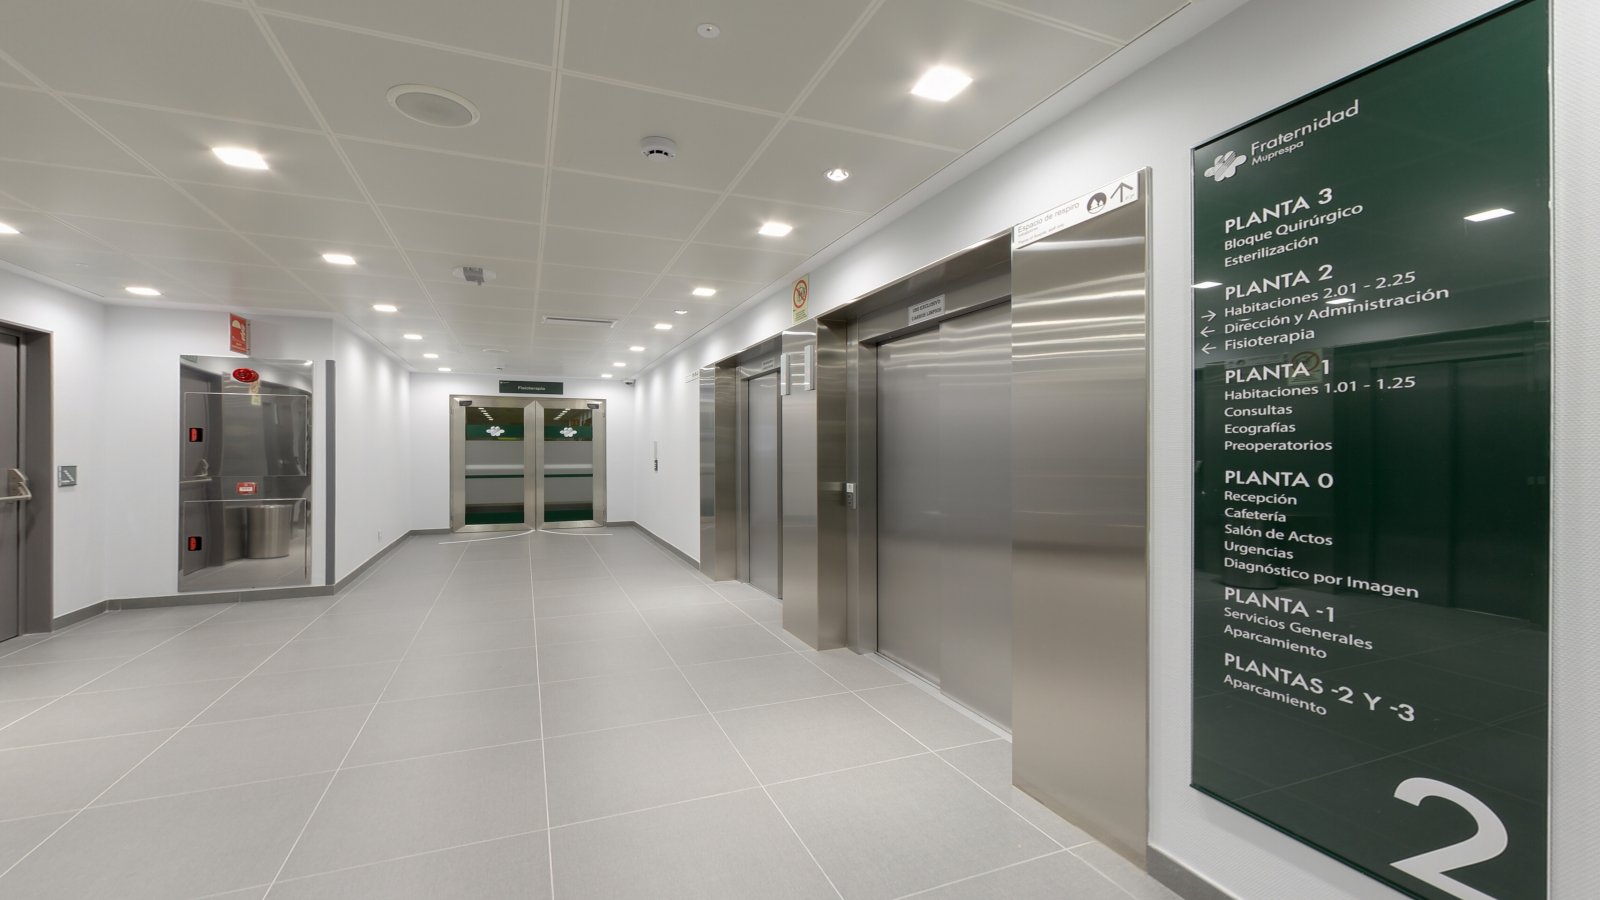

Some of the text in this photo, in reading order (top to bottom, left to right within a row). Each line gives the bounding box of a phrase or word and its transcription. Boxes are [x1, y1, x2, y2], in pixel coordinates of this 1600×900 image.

[1251, 99, 1359, 156] Fraternidad
[1251, 141, 1304, 166] Muprespa
[1018, 218, 1043, 233] Espacio
[1044, 213, 1053, 222] de
[1054, 202, 1080, 217] respiro
[1224, 204, 1364, 251] Bloque Quirúrgico
[1225, 188, 1333, 234] PLANTA 3
[1224, 235, 1319, 268] Esterilización
[1224, 291, 1319, 317] Habitaciones
[1323, 283, 1357, 299] 2.01
[1375, 271, 1416, 290] 2.25
[1225, 264, 1333, 301] PLANTA 2
[1224, 287, 1450, 334] Dirección y Administración
[1224, 328, 1315, 351] Fisioterapia
[1225, 359, 1330, 384] PLANTA 1
[1224, 384, 1319, 401] Habitaciones
[1324, 381, 1357, 394] 1.01
[1376, 376, 1416, 390] 1.25
[1224, 404, 1293, 417] Consultas
[1224, 422, 1296, 436] Ecografías
[1224, 440, 1333, 452] Preoperatorios
[1225, 470, 1334, 489] PLANTA 0
[1224, 491, 1297, 505] Recepción
[1224, 507, 1287, 523] Cafetería
[1224, 524, 1333, 546] Salón de Actos
[1224, 541, 1294, 560] Urgencias
[1224, 557, 1419, 598] Diagnóstico por Imagen
[1225, 587, 1335, 623] PLANTA -1
[1224, 607, 1373, 650] Servicios Generales
[1224, 624, 1327, 659] Aparcamiento
[1224, 674, 1327, 716] Aparcamiento
[1225, 652, 1415, 722] PLANTAS -2 Y -3
[1389, 777, 1508, 900] 2
